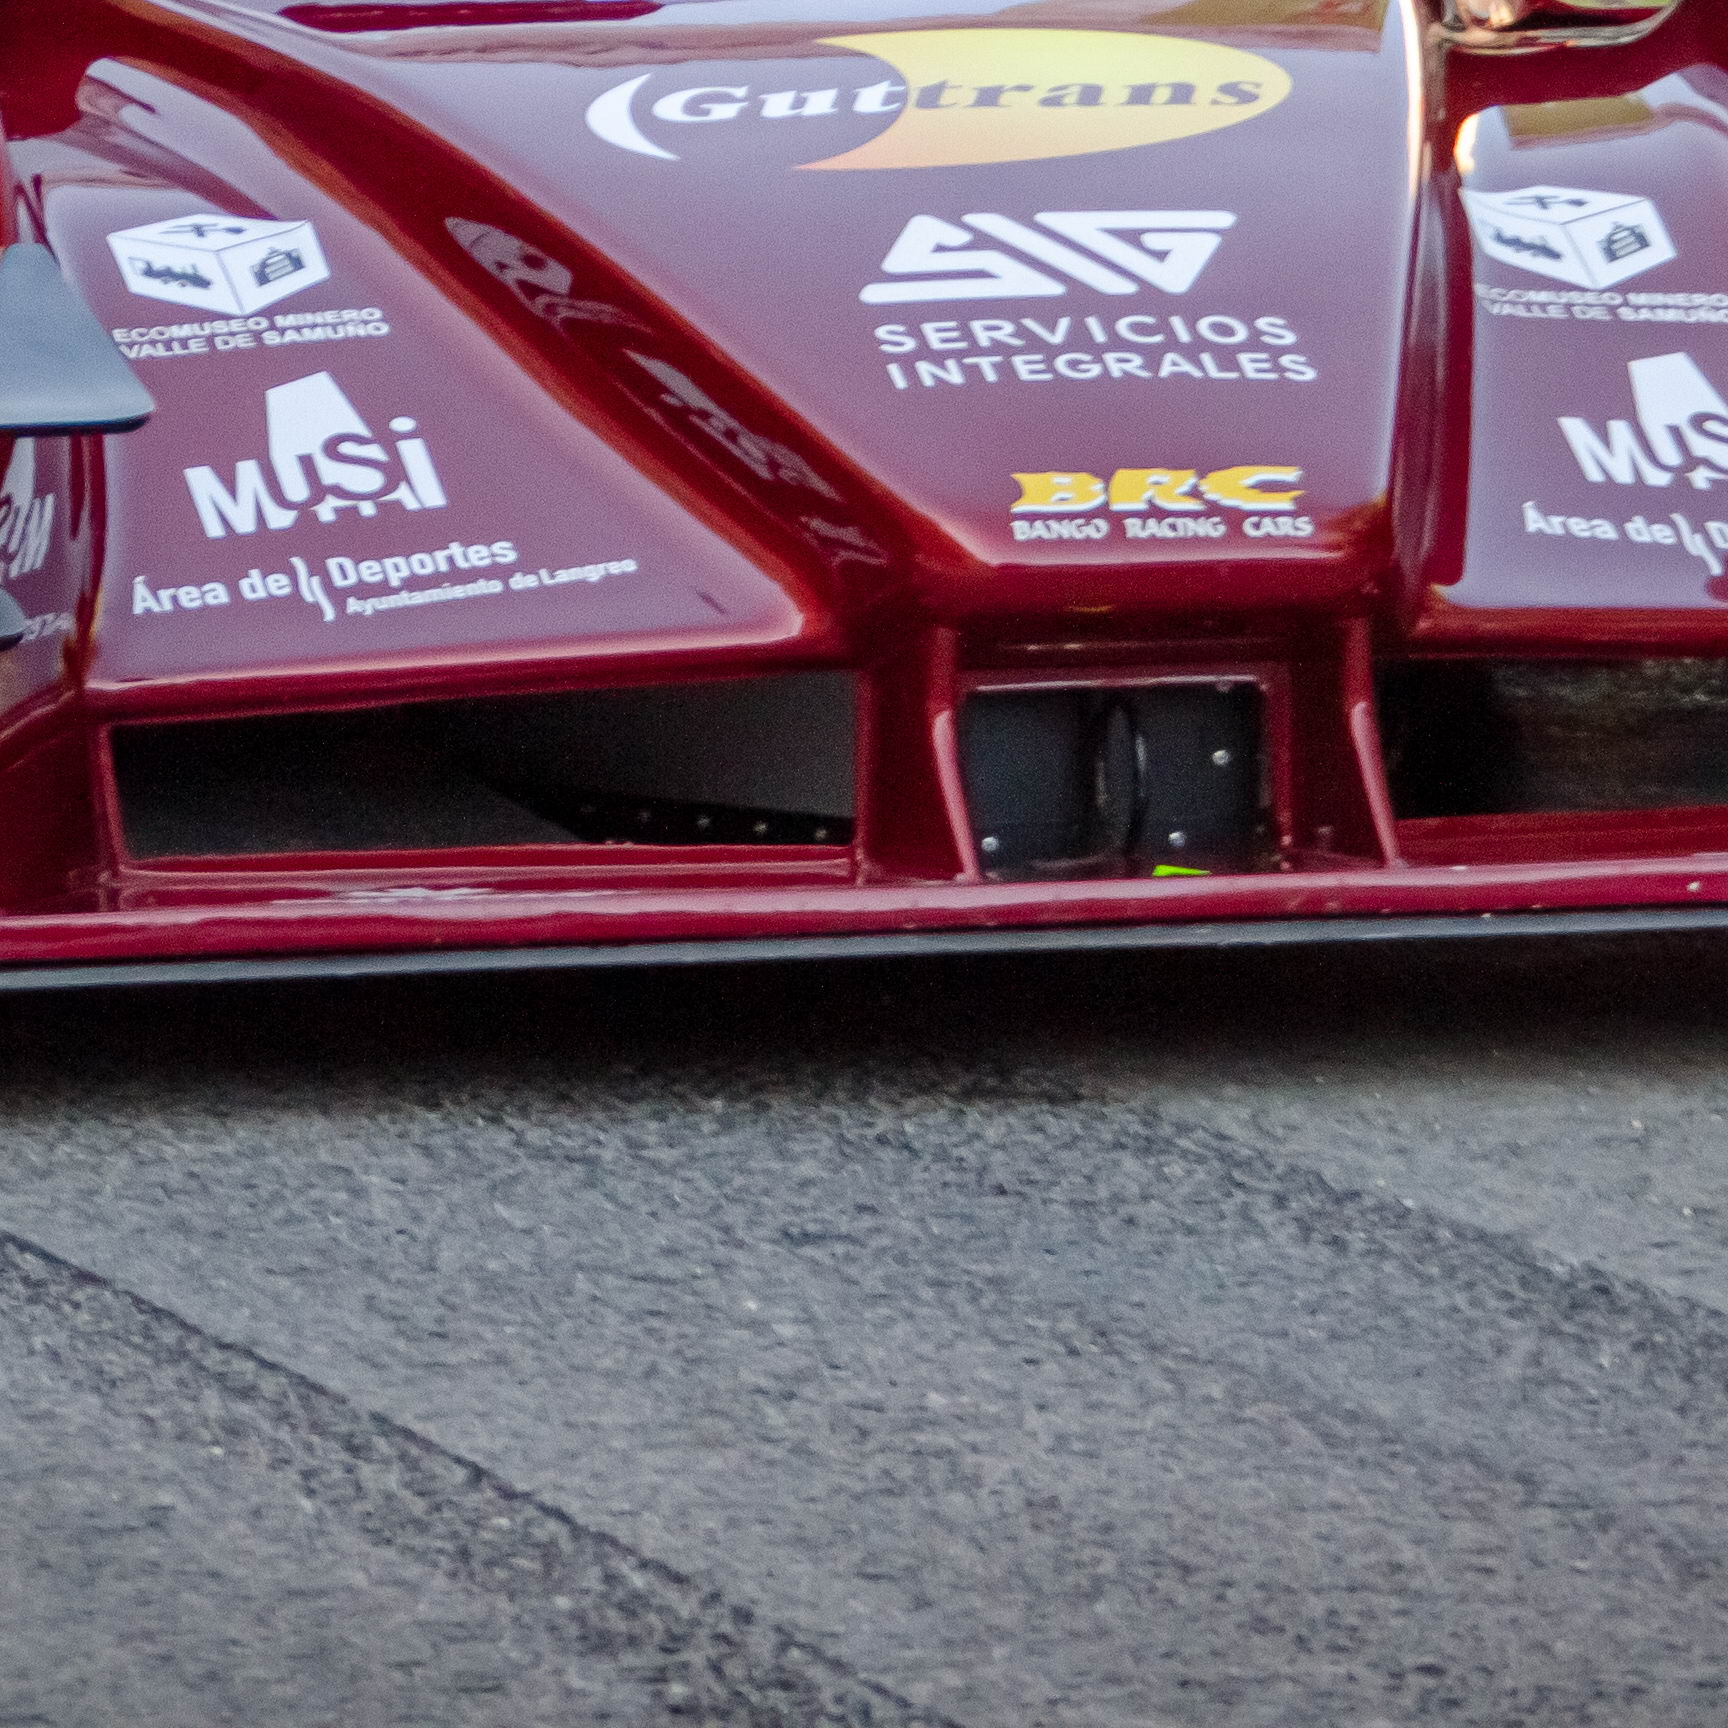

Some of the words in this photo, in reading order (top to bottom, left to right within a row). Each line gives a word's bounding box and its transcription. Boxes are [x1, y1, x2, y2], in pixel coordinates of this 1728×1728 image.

[652, 73, 1266, 124] Guttrans
[111, 316, 270, 343] ECOMUSEO
[273, 307, 384, 329] MINERO
[118, 337, 211, 359] VALLE
[214, 332, 258, 351] DE
[874, 314, 1297, 355] SERVICIOS
[884, 350, 1318, 390] INTEGRALES
[1010, 465, 1307, 514] BRC
[1122, 516, 1227, 540] RACING
[1242, 515, 1315, 539] CARS
[1522, 500, 1619, 541] Área
[1624, 515, 1678, 544] de
[132, 575, 230, 615] Área
[239, 568, 293, 601] de
[325, 539, 519, 589] Deportes
[346, 577, 504, 616] Ayuntamiento
[540, 557, 638, 586] Langreo
